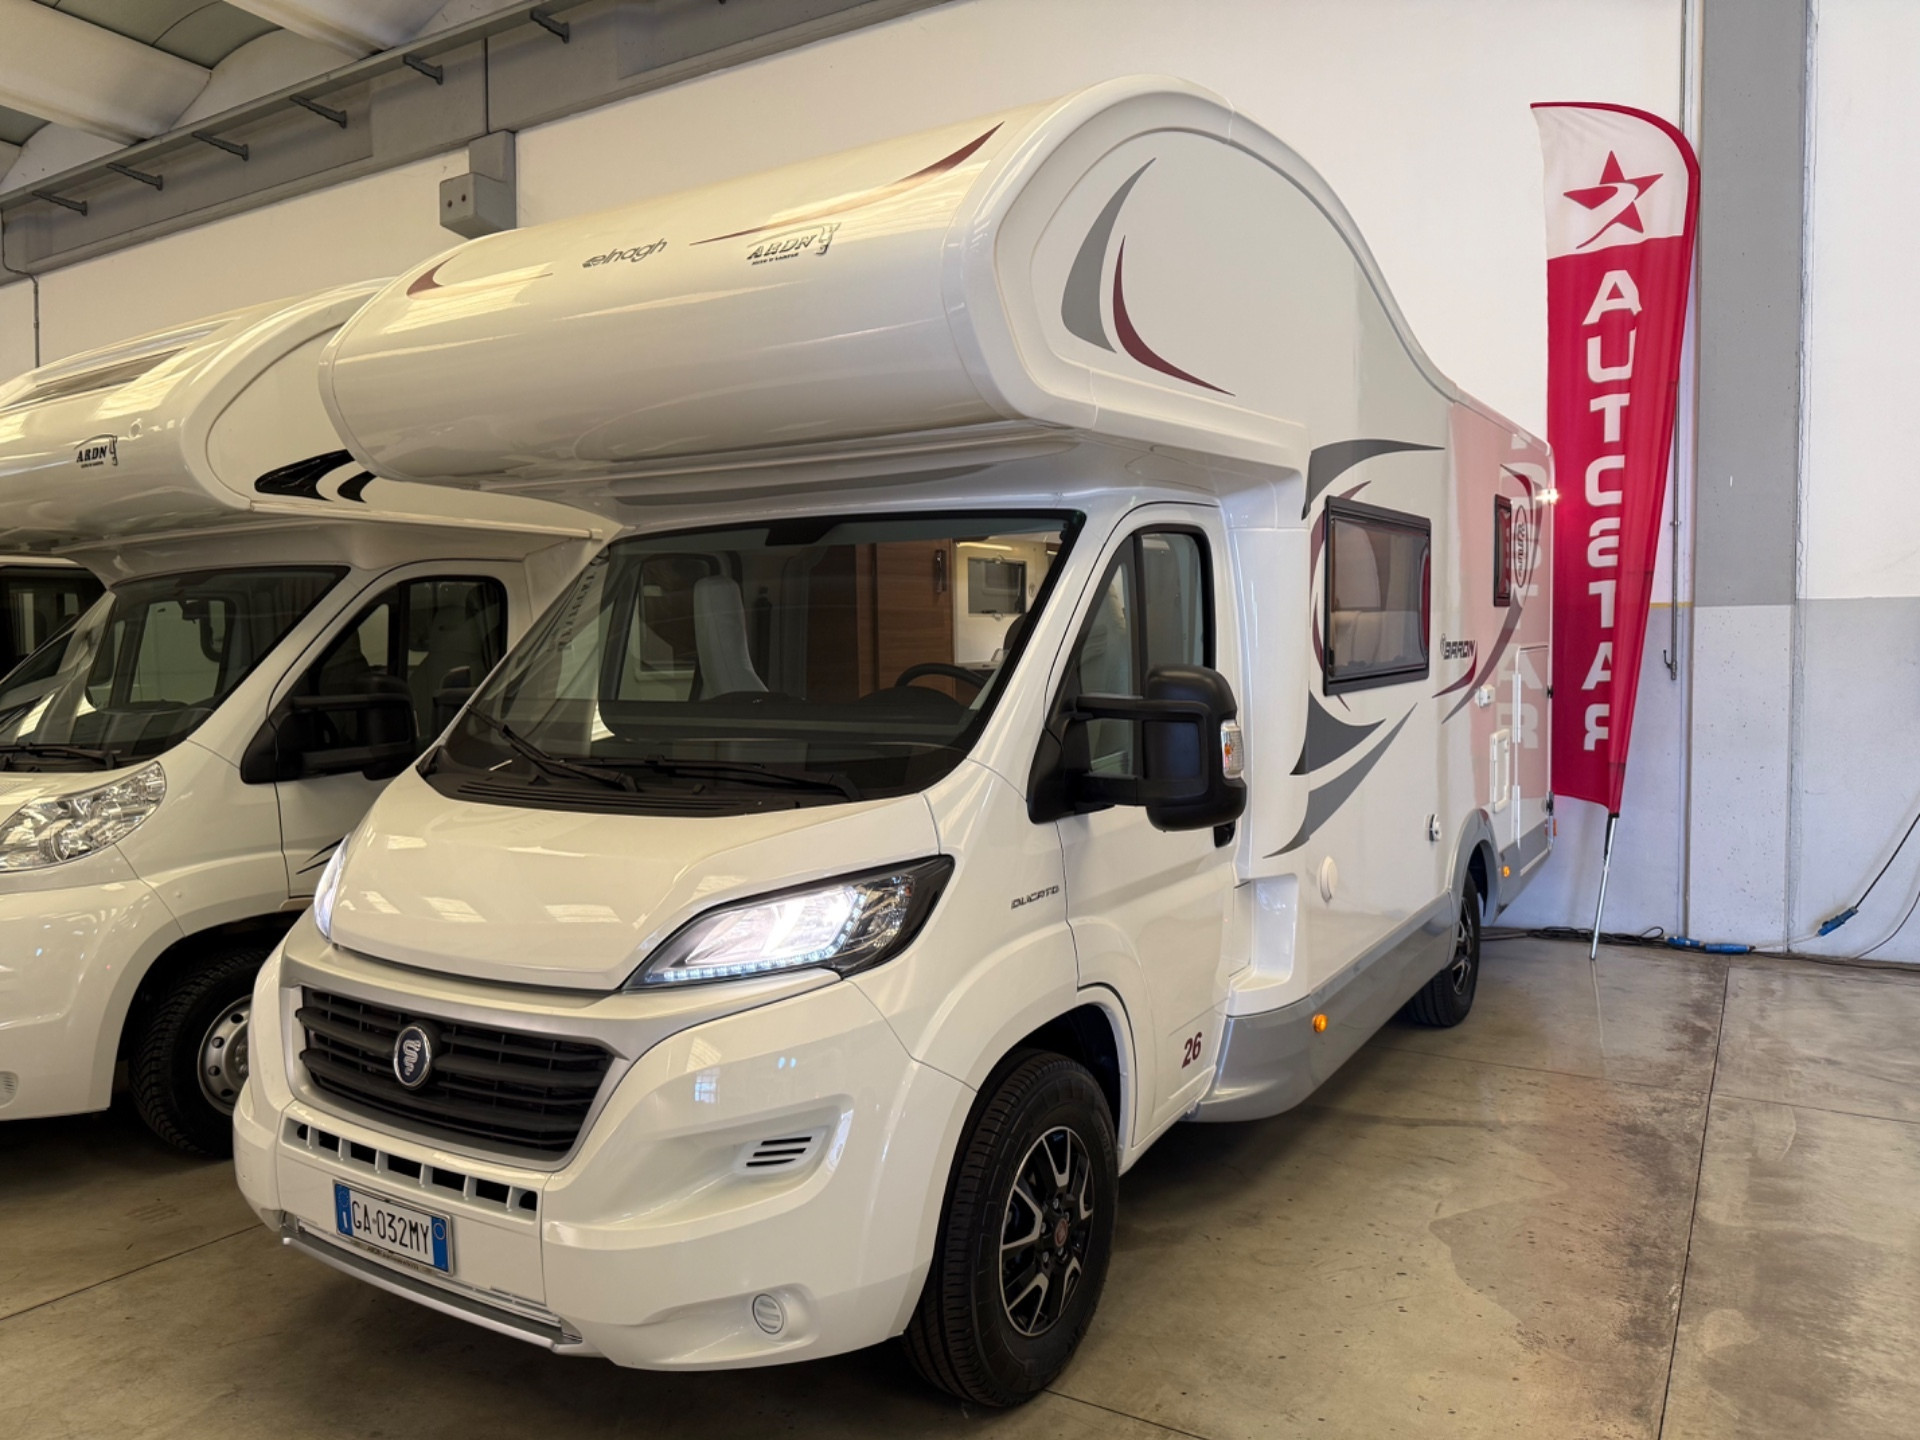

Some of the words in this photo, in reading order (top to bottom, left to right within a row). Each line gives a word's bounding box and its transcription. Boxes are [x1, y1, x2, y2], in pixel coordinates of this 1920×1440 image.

[582, 238, 667, 268] elnagh
[1011, 885, 1060, 909] DUCATO
[1181, 1031, 1202, 1069] 26
